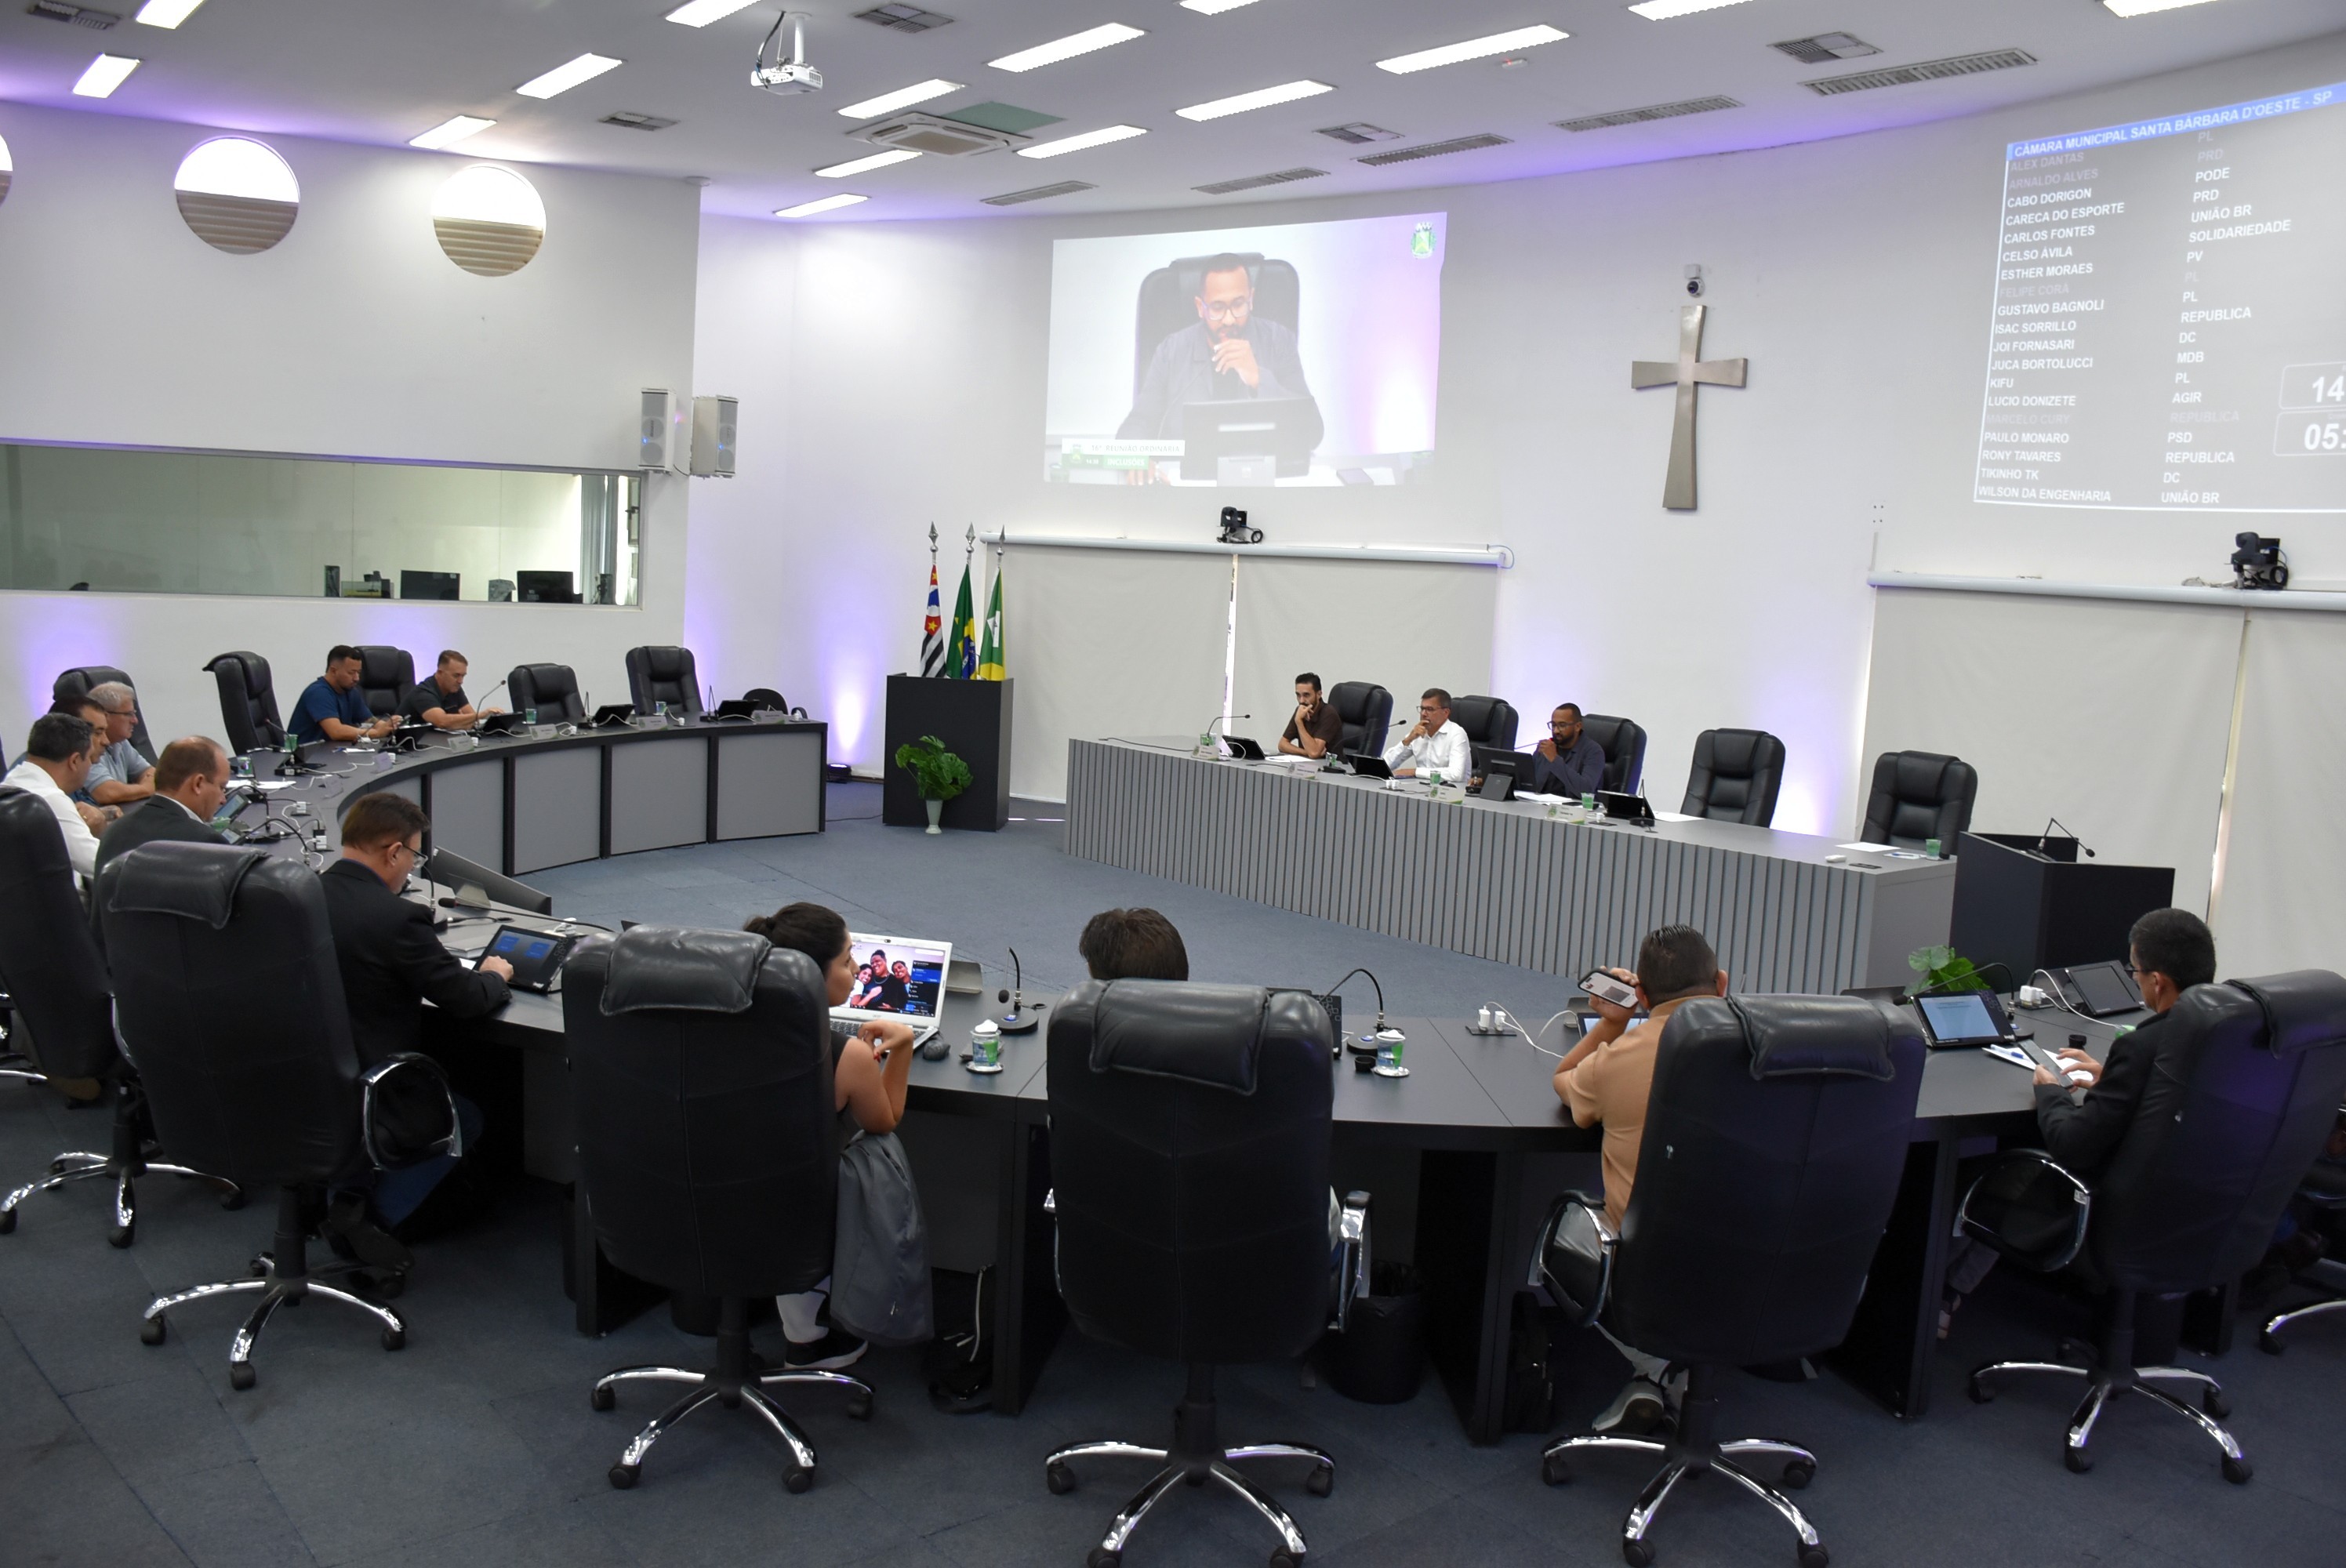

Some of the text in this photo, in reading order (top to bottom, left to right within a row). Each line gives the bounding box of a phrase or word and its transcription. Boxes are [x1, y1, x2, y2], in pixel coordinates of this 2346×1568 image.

[2065, 129, 2127, 149] MUNICIPAL
[2130, 121, 2171, 138] SANTA
[2174, 110, 2239, 132] BÁRBARA
[2242, 97, 2301, 118] D'OESTE
[2312, 91, 2332, 105] SP
[2198, 131, 2213, 143] PL
[2010, 152, 2084, 171] ALEX DANTAS
[2198, 148, 2224, 162] PRD
[2009, 169, 2098, 190] ARNALDO ALVES
[2195, 167, 2230, 183] PODE
[2007, 188, 2091, 208] CABO DORIGON
[2193, 189, 2219, 202] PRD
[2006, 202, 2124, 226] CARECA DO ESPORTE
[2192, 205, 2252, 223] UNIÃO BR
[2004, 225, 2095, 244] CARLOS FONTES
[2188, 220, 2291, 243] SOLIDARIEDADE
[2003, 246, 2072, 262] CELSO ÁVILA
[2186, 251, 2203, 263] PV
[2001, 263, 2093, 280] ESTHER MORAES
[1999, 286, 2035, 299] FELIPE
[2183, 291, 2198, 303] PL
[1997, 299, 2104, 316] GUSTAVO BAGNOLI
[2181, 307, 2251, 323] REPUBLICA
[1995, 321, 2076, 334] ISAC SORRILLO
[2179, 332, 2195, 343] DC
[1993, 339, 2075, 352] JOI FORNASARI
[2177, 351, 2204, 363] MDB
[1992, 358, 2093, 370] JUCA BORTOLUCCI
[1990, 378, 2014, 388] KIFU
[2175, 372, 2189, 383] PL
[2312, 375, 2344, 403] 14
[1988, 396, 2076, 406] LUCIO DONIZETE
[2172, 391, 2201, 403] AGIR
[1984, 432, 2069, 443] PAULO MONARO
[2167, 432, 2192, 443] PSD
[1982, 450, 2061, 462] RONY TAVARES
[2166, 452, 2235, 463] REPUBLICA
[1981, 468, 2039, 480] TIKINHO TK
[2163, 472, 2180, 483] DC
[1978, 486, 2111, 501] WILSON DA ENGENHARIA
[2161, 489, 2220, 503] UNIÃO BR
